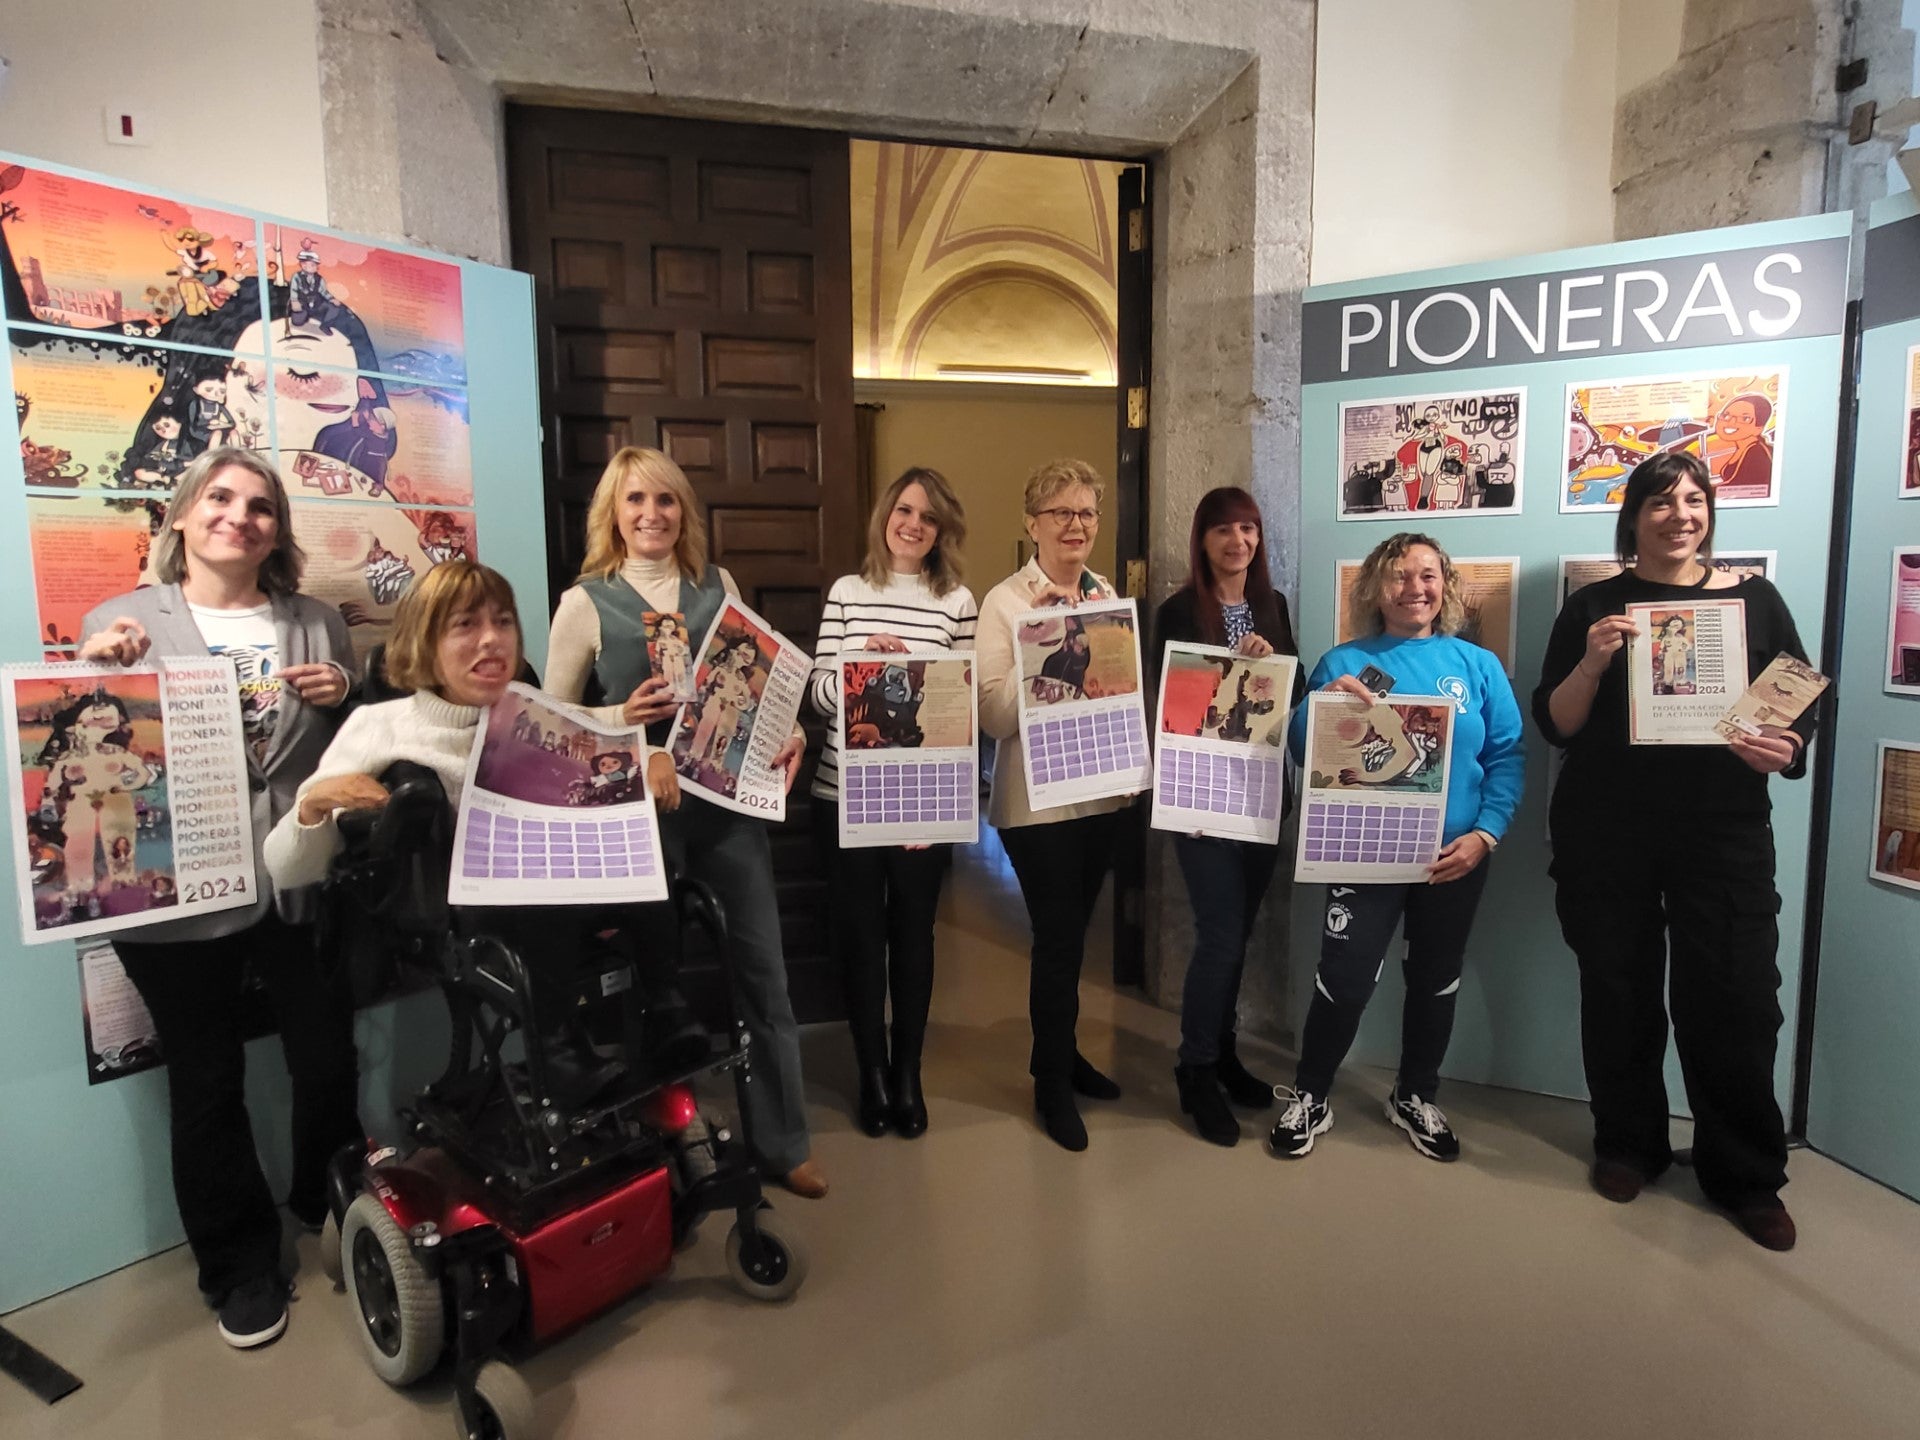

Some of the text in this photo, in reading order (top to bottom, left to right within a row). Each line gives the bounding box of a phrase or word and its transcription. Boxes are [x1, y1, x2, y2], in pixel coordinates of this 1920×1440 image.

[1340, 252, 1802, 373] PIONERAS
[1699, 685, 1726, 694] 2024
[175, 784, 237, 799] PIONERAS
[740, 791, 779, 812] 2024
[177, 812, 239, 829] PIONERAS
[179, 840, 241, 857] PIONERAS
[180, 853, 242, 872] PIONERAS
[184, 876, 247, 904] 2024
